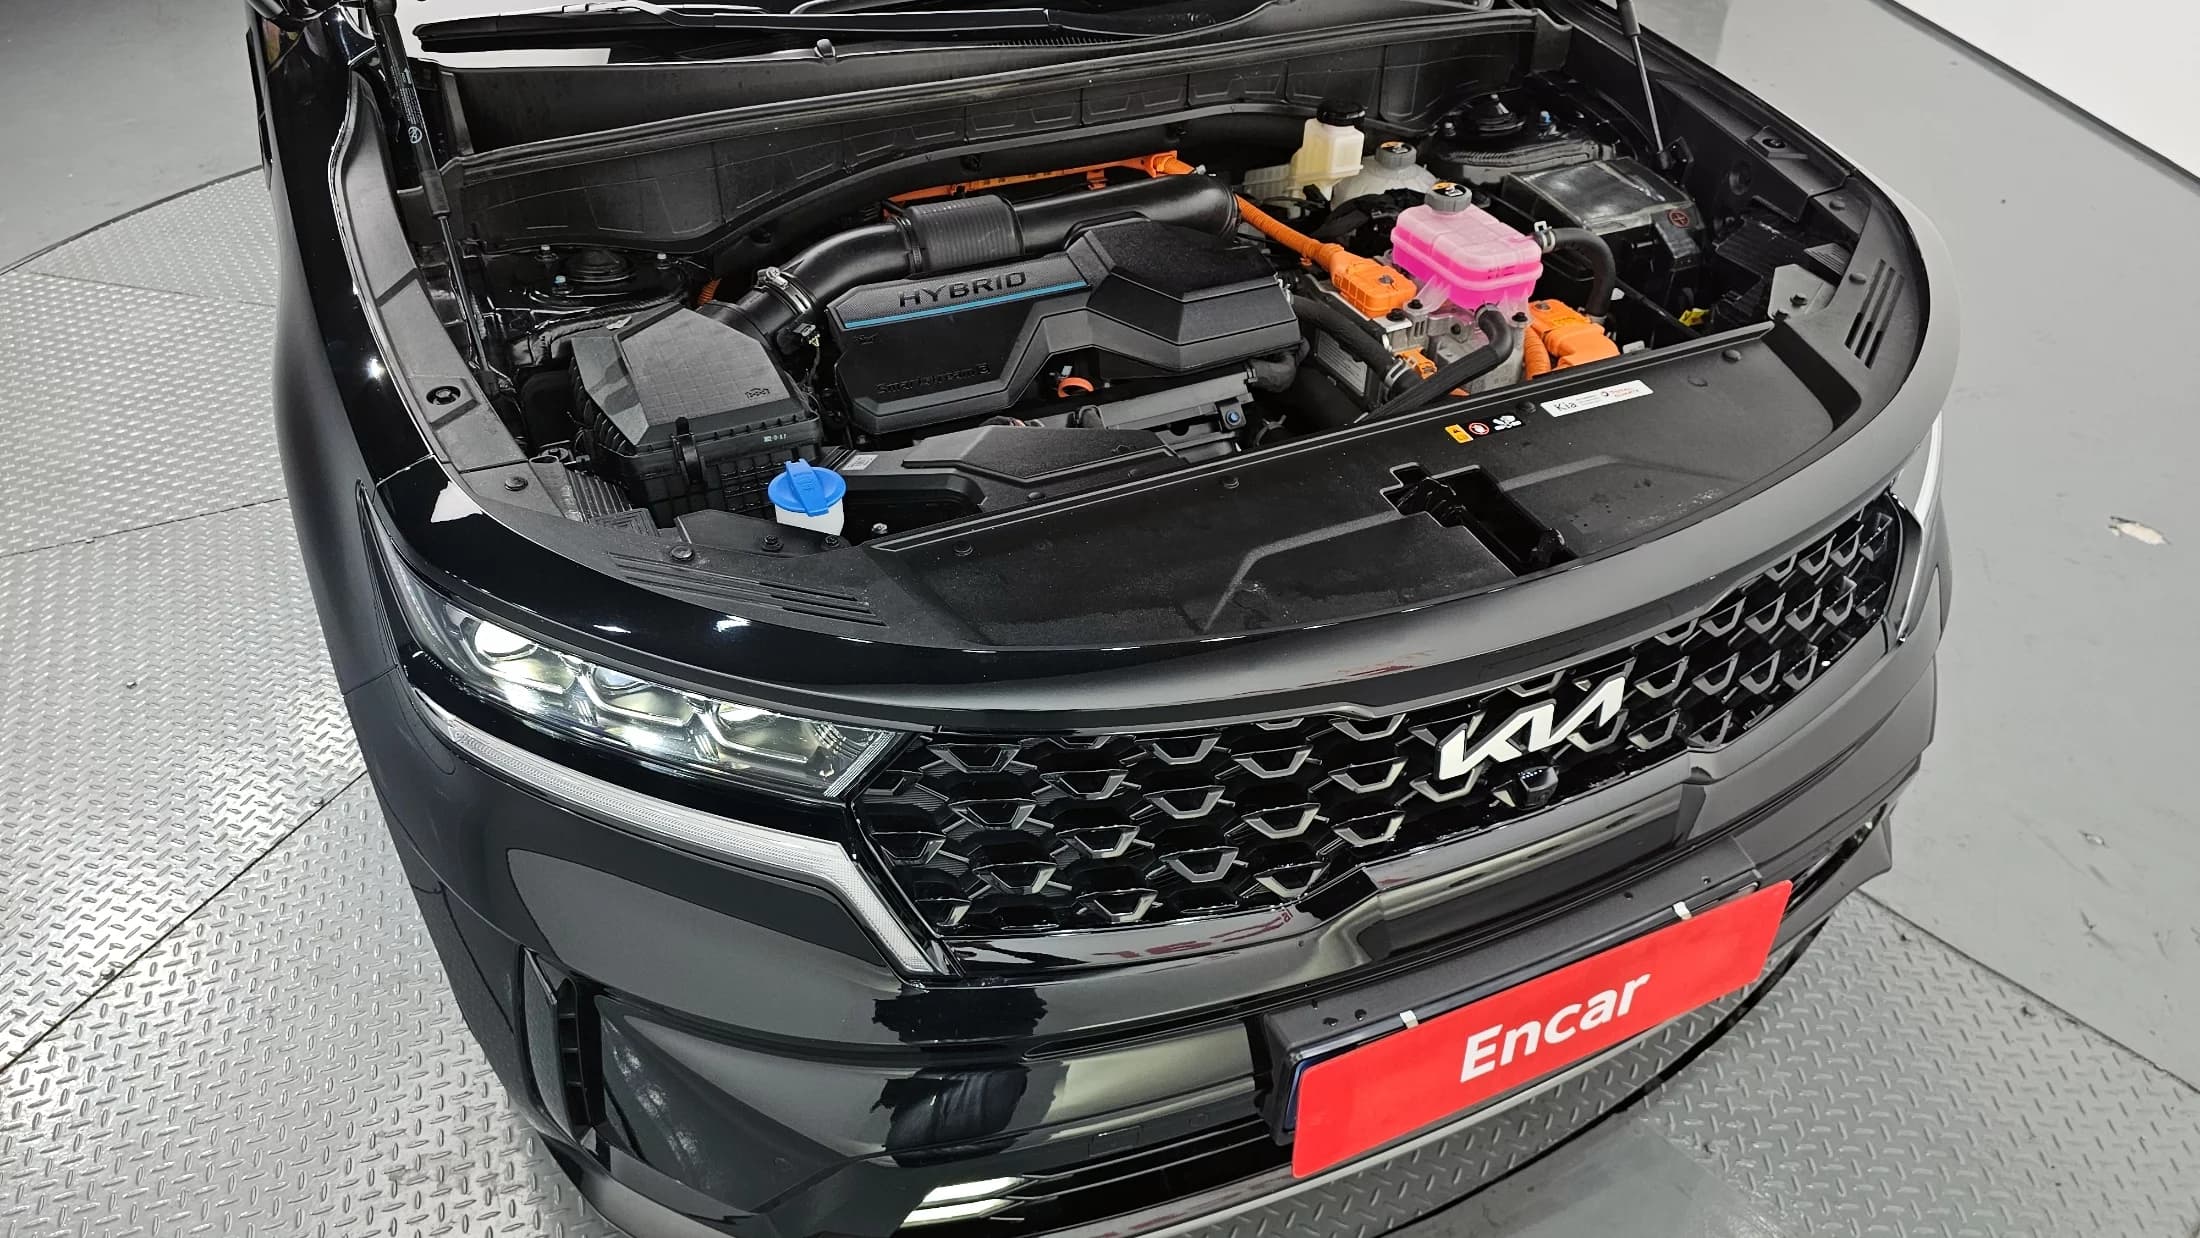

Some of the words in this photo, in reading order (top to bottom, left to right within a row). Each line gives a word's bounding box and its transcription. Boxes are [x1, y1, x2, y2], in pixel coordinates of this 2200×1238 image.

[899, 272, 1027, 307] HYBRID
[1436, 673, 1627, 780] KIA
[1460, 973, 1652, 1084] Encar
